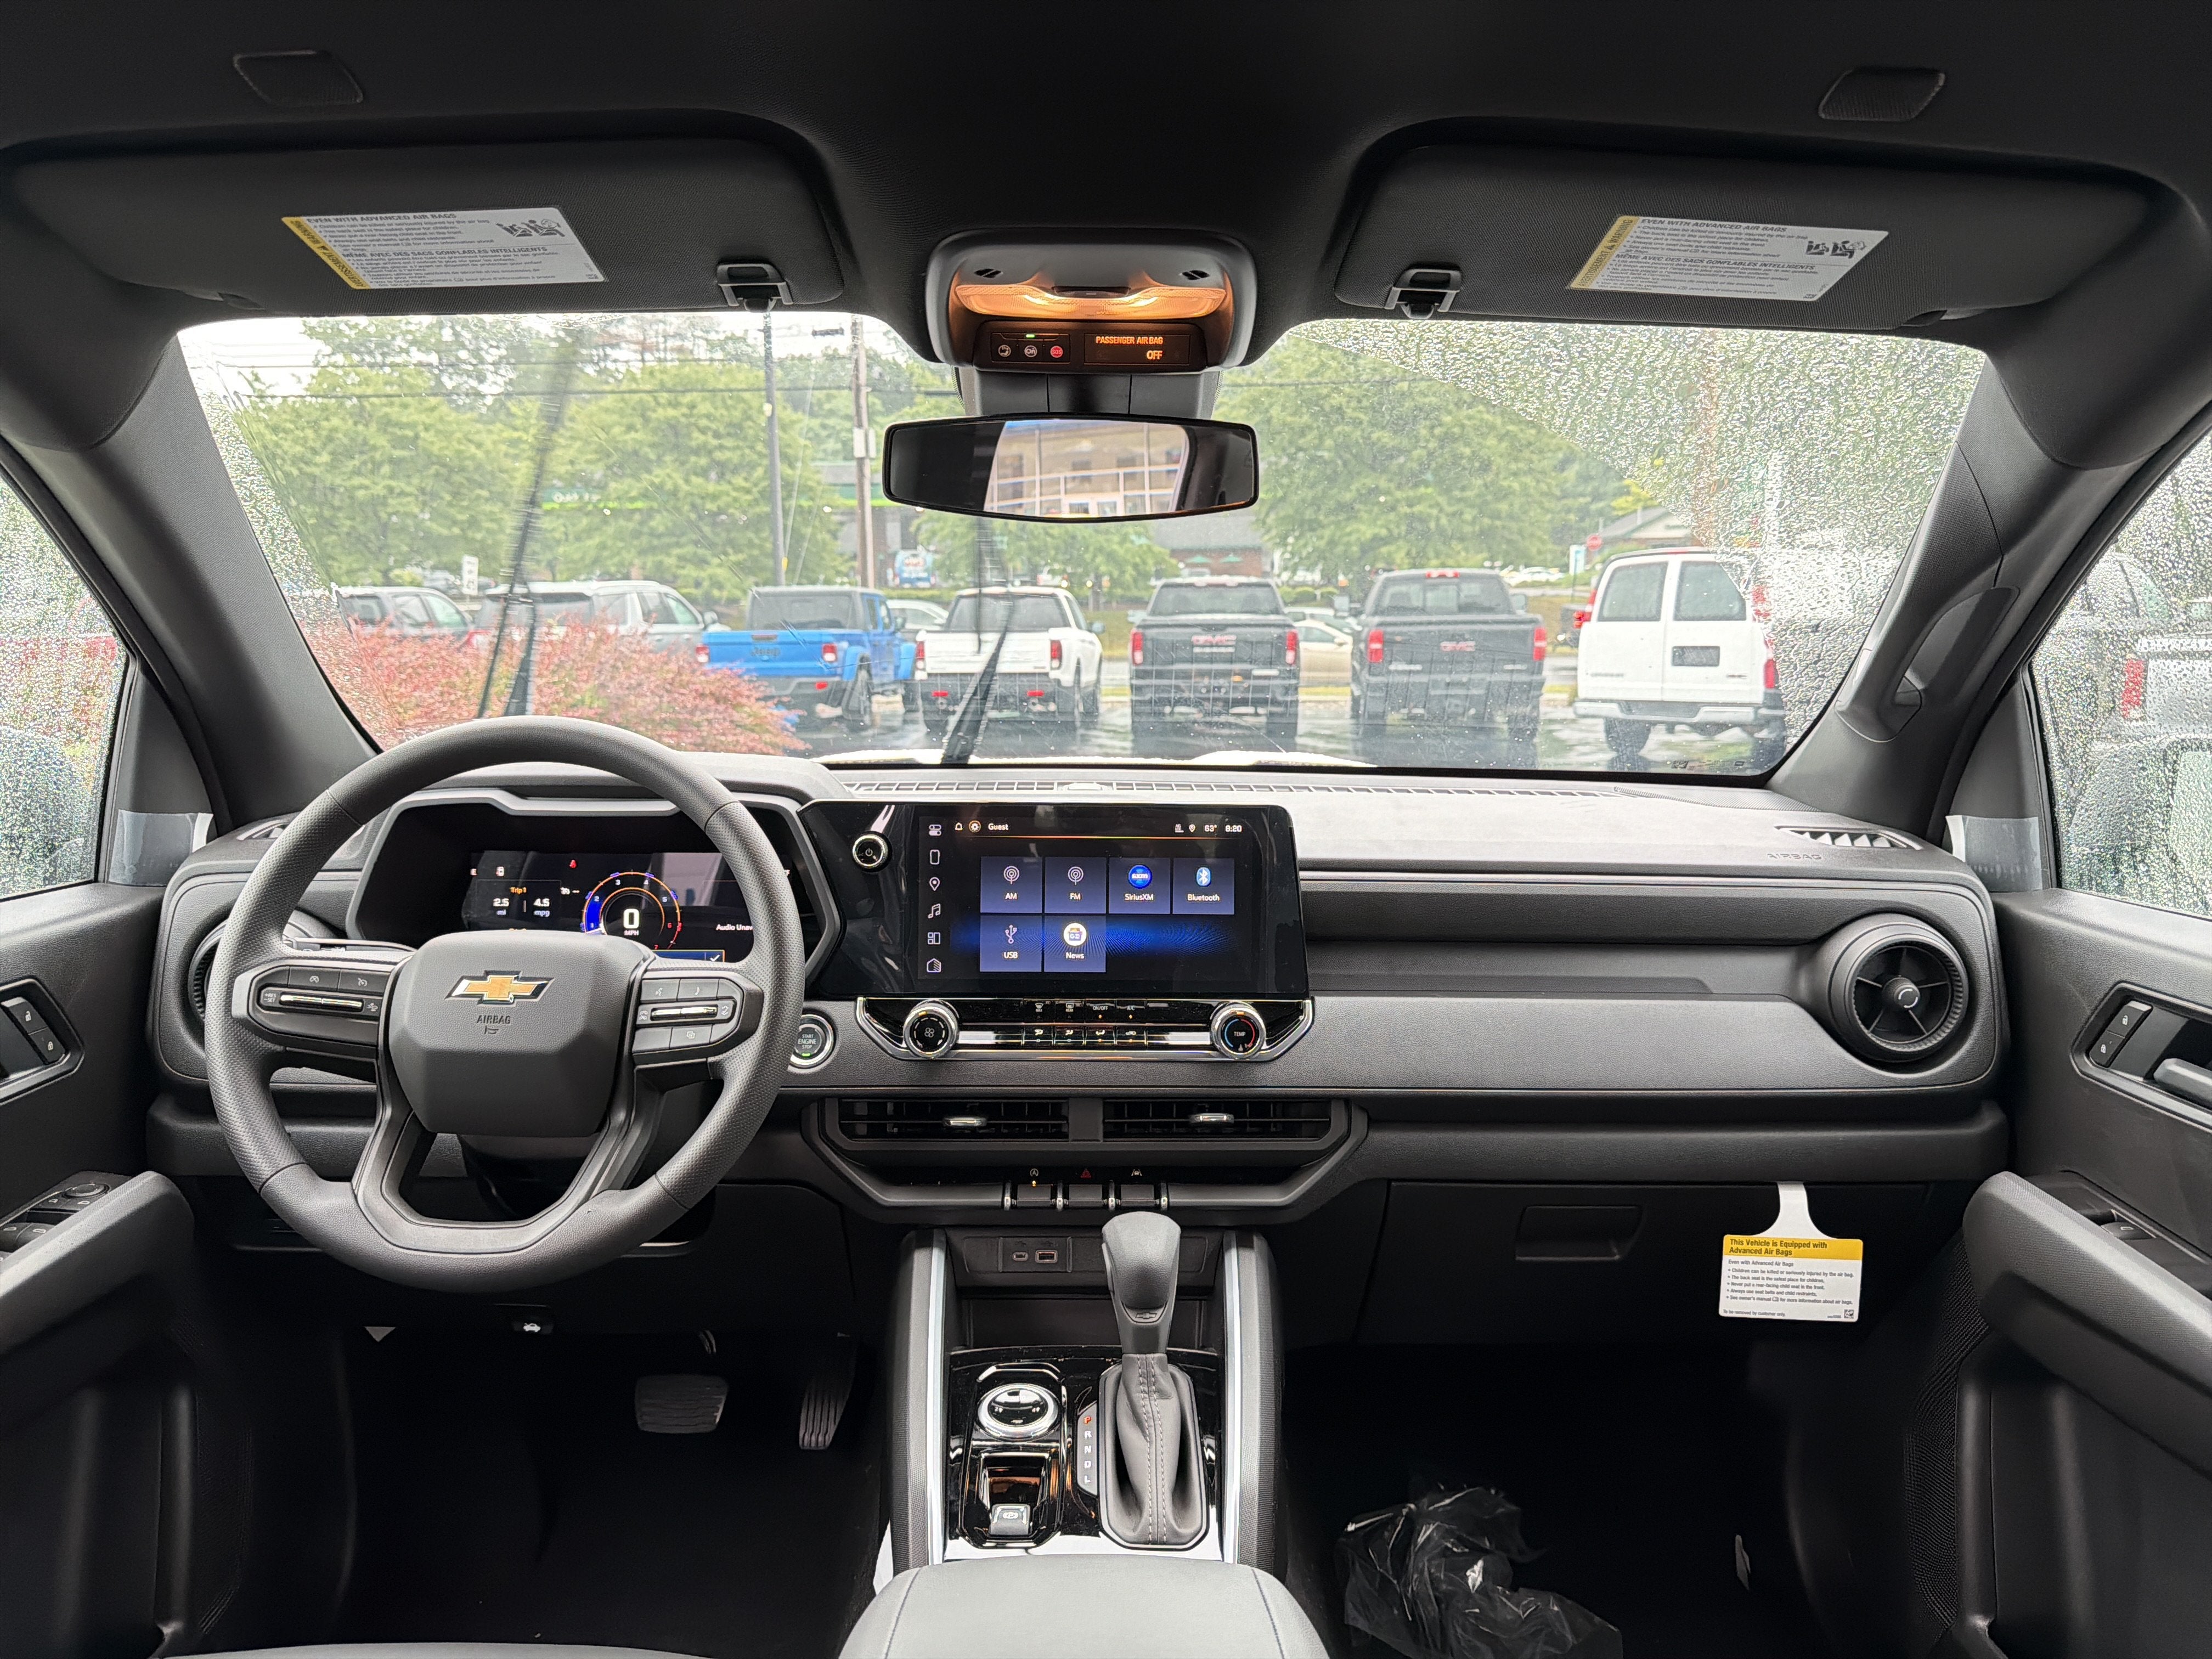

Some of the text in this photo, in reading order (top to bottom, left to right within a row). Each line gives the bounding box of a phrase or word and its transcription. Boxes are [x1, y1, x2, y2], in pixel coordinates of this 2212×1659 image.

[1096, 336, 1163, 345] PASSENGER AIR BAG
[1147, 351, 1163, 359] OFF
[1191, 634, 1237, 645] GMC
[1440, 641, 1476, 651] GMC
[988, 823, 1009, 832] Guest
[509, 887, 523, 895] Trip
[493, 898, 510, 907] 2.5
[533, 898, 550, 907] 4.5
[623, 909, 639, 929] 0
[477, 1015, 511, 1024] AIRBAG
[1780, 1240, 1811, 1249] Equipped
[1084, 1416, 1092, 1424] P
[1084, 1430, 1092, 1438] R
[1084, 1445, 1092, 1453] N
[1084, 1475, 1091, 1484] L
